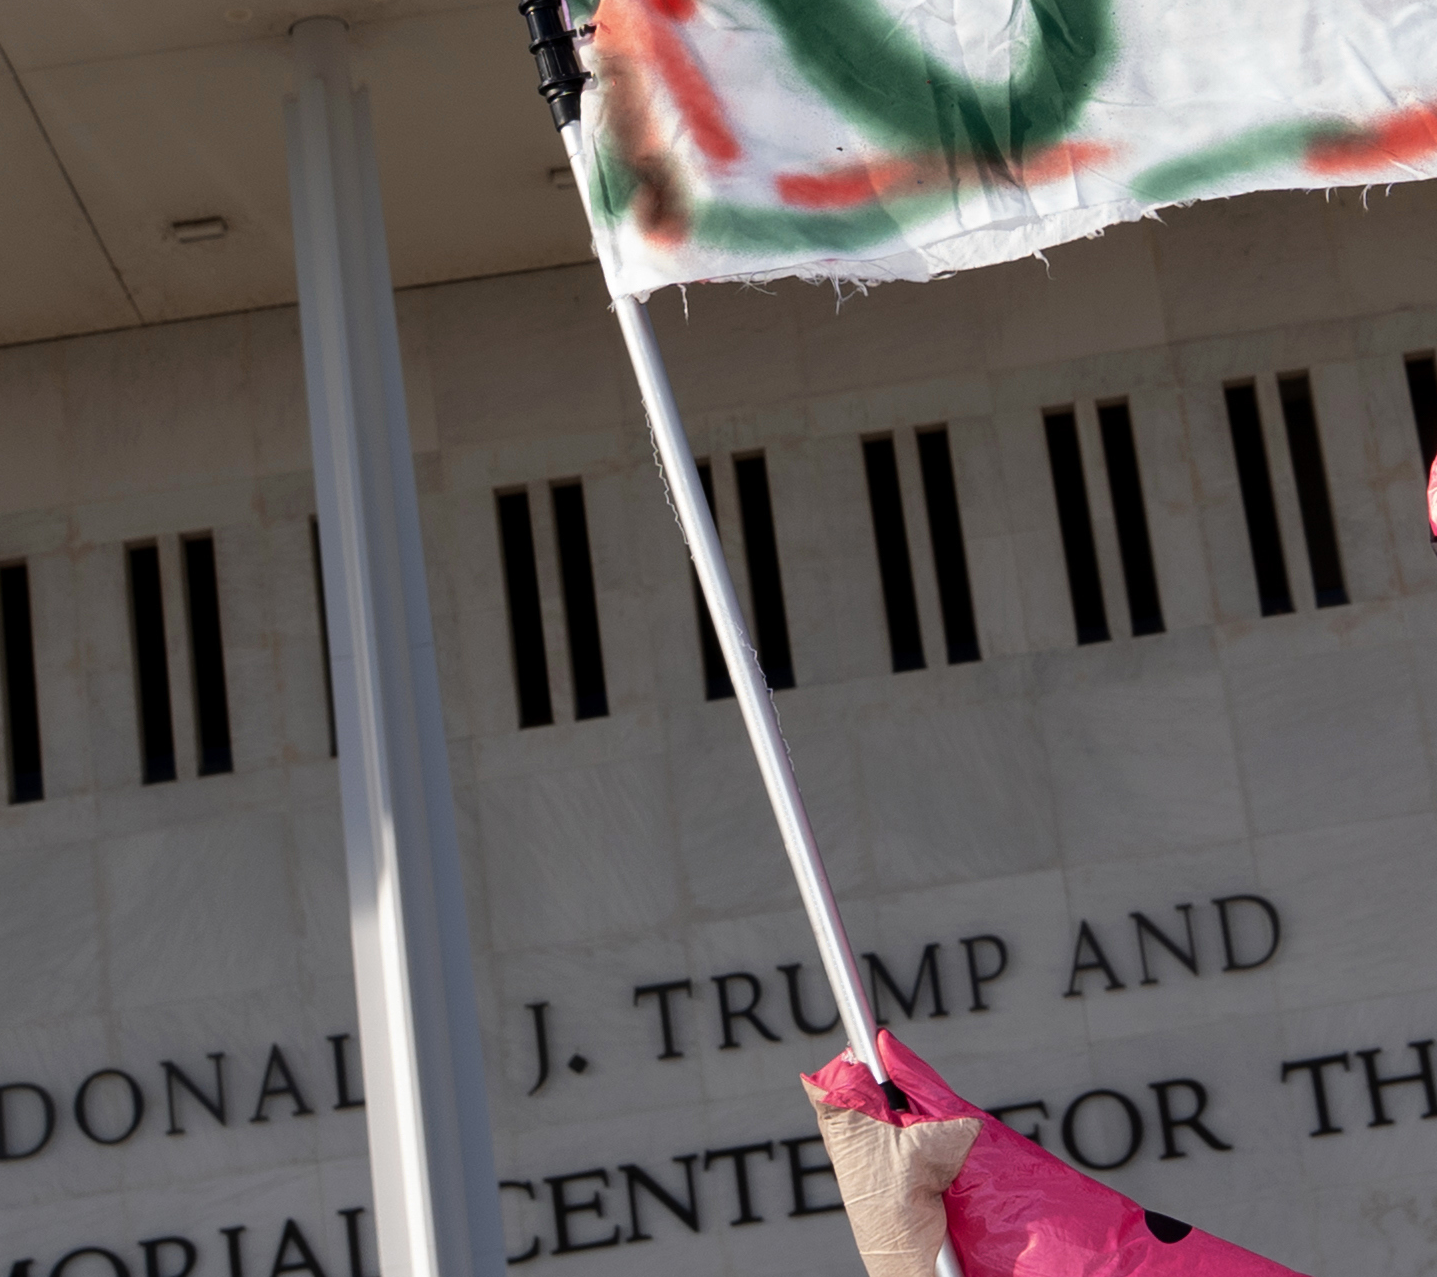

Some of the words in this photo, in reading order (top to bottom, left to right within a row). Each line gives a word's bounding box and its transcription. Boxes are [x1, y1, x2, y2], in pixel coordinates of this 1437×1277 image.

[525, 1000, 591, 1097] J.
[631, 933, 1009, 1061] TRUMP
[1062, 892, 1282, 999] AND
[497, 1132, 848, 1266] CENTE
